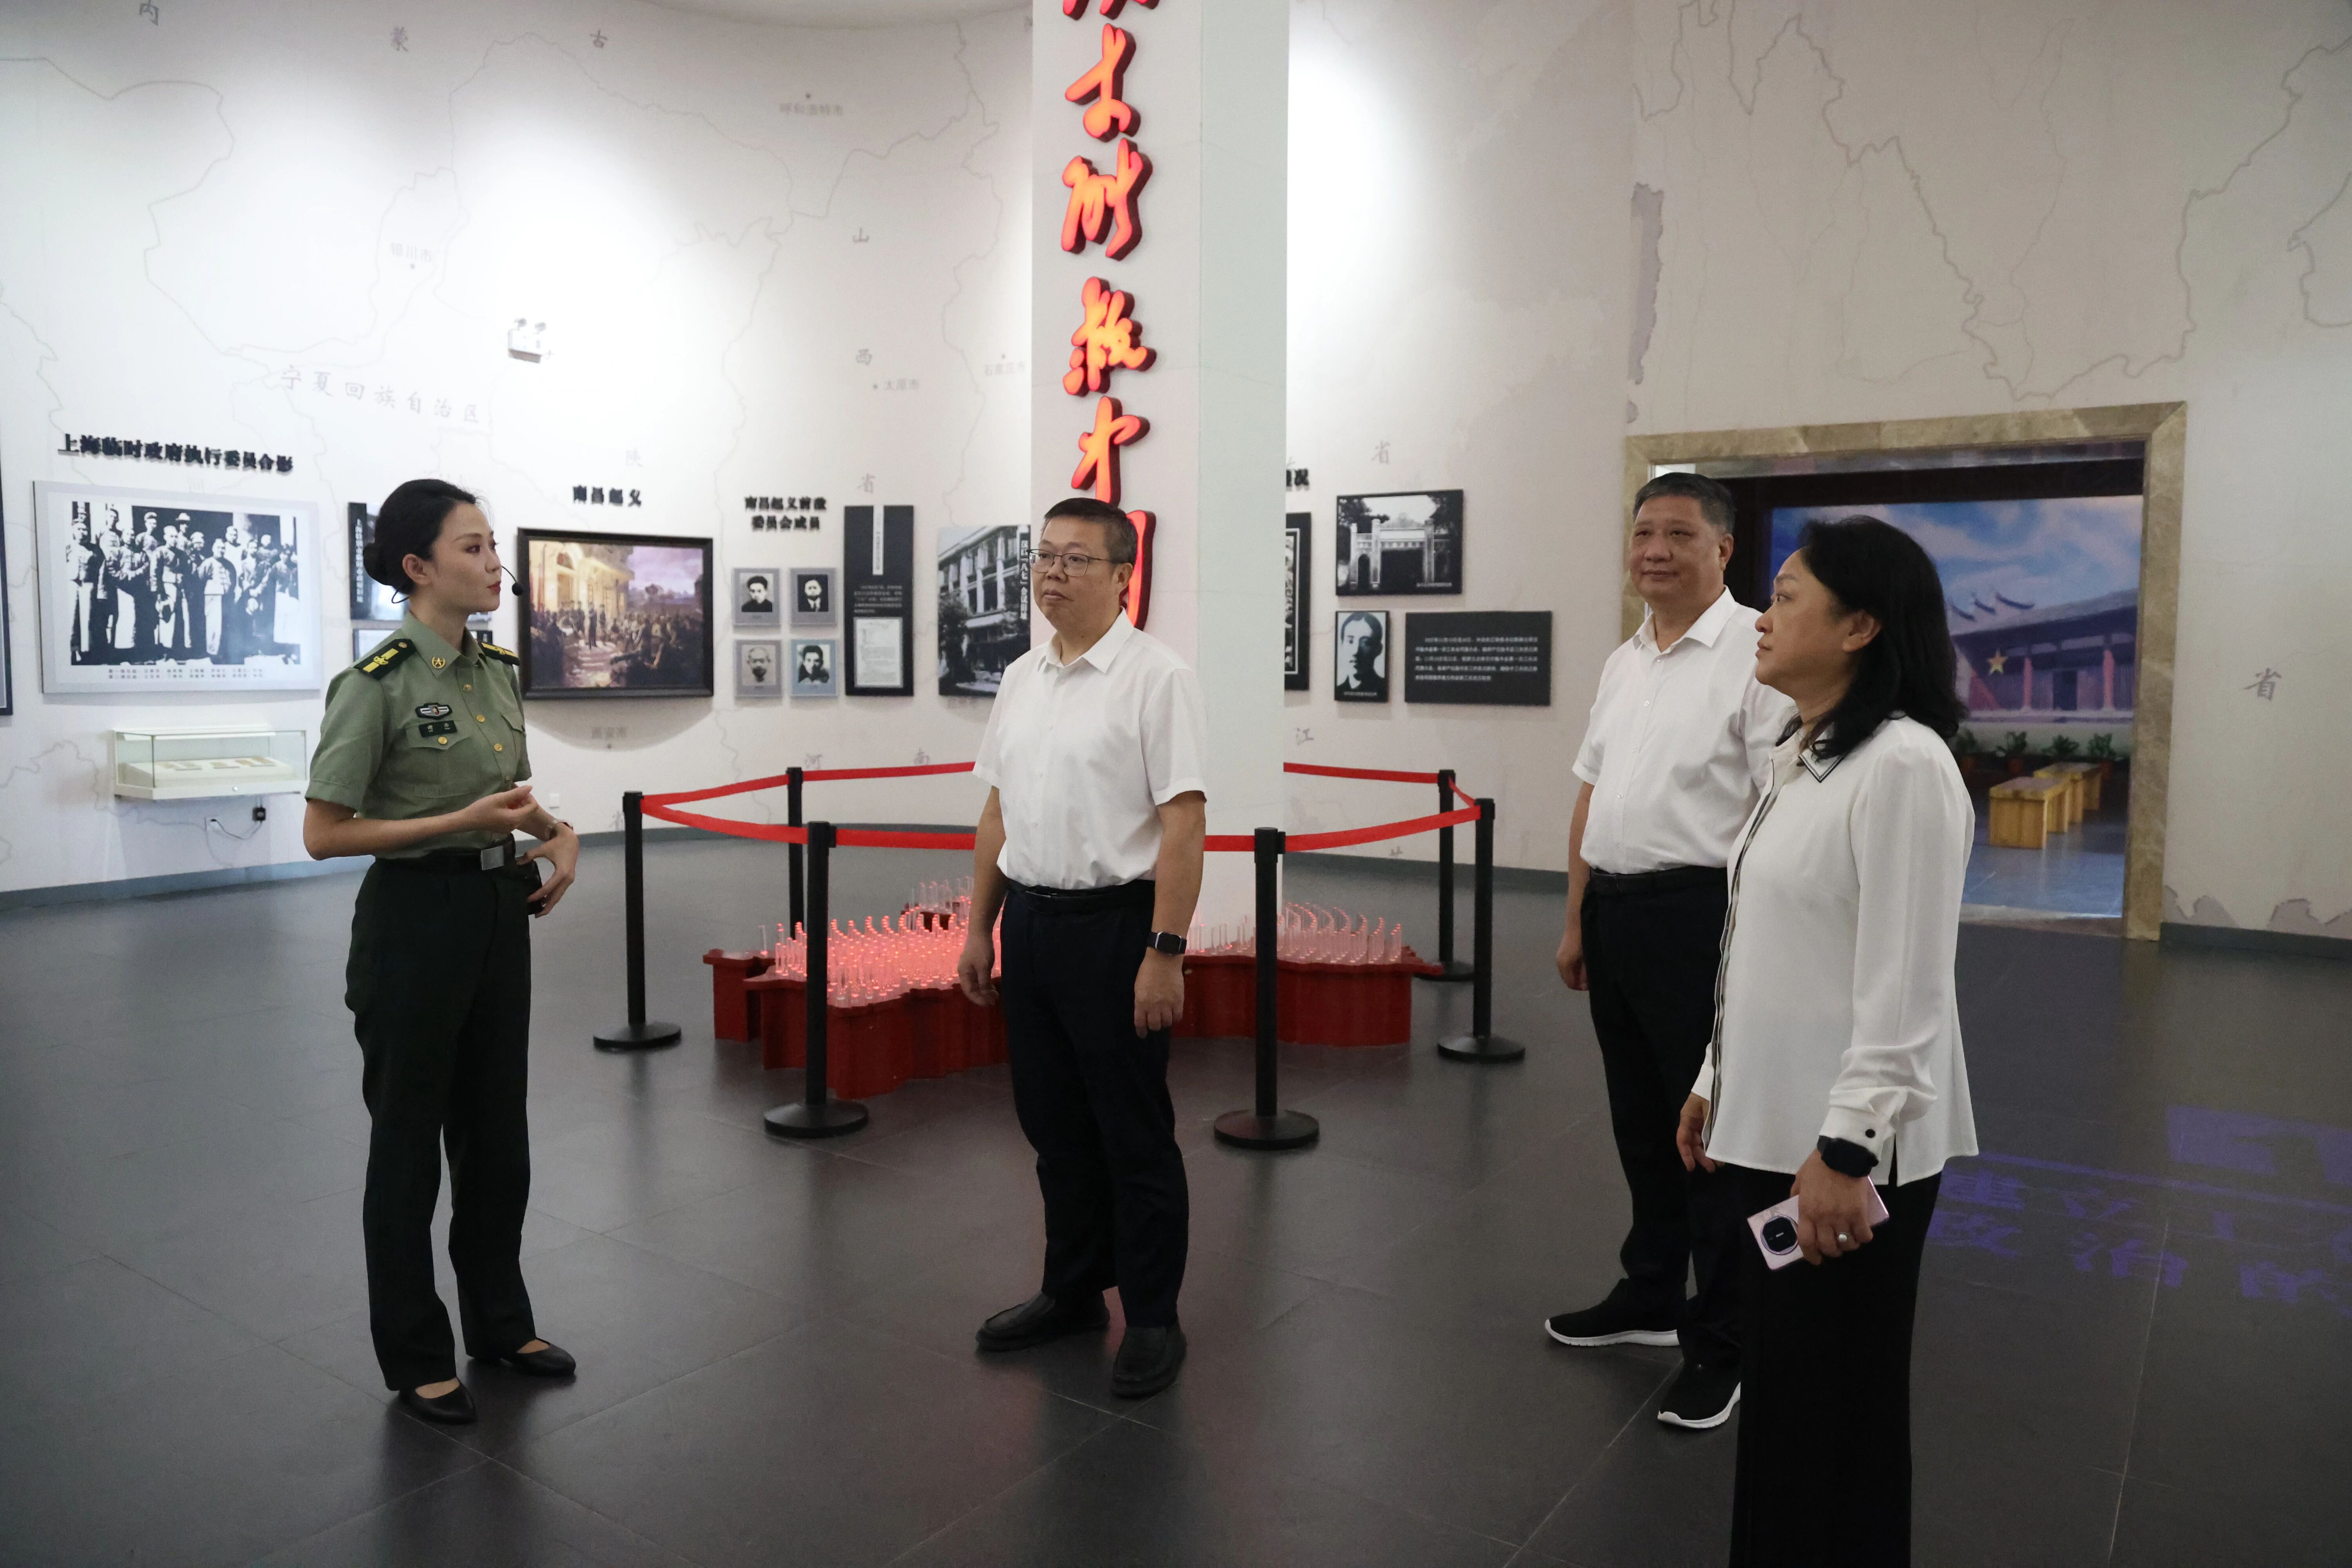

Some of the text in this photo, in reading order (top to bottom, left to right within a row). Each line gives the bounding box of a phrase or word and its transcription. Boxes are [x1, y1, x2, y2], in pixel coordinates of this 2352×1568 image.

[139, 0, 159, 26] 内
[589, 29, 608, 48] 古
[852, 227, 869, 243] 山
[856, 473, 876, 494] 省
[573, 485, 642, 506] 南昌起义
[2244, 667, 2283, 702] 省
